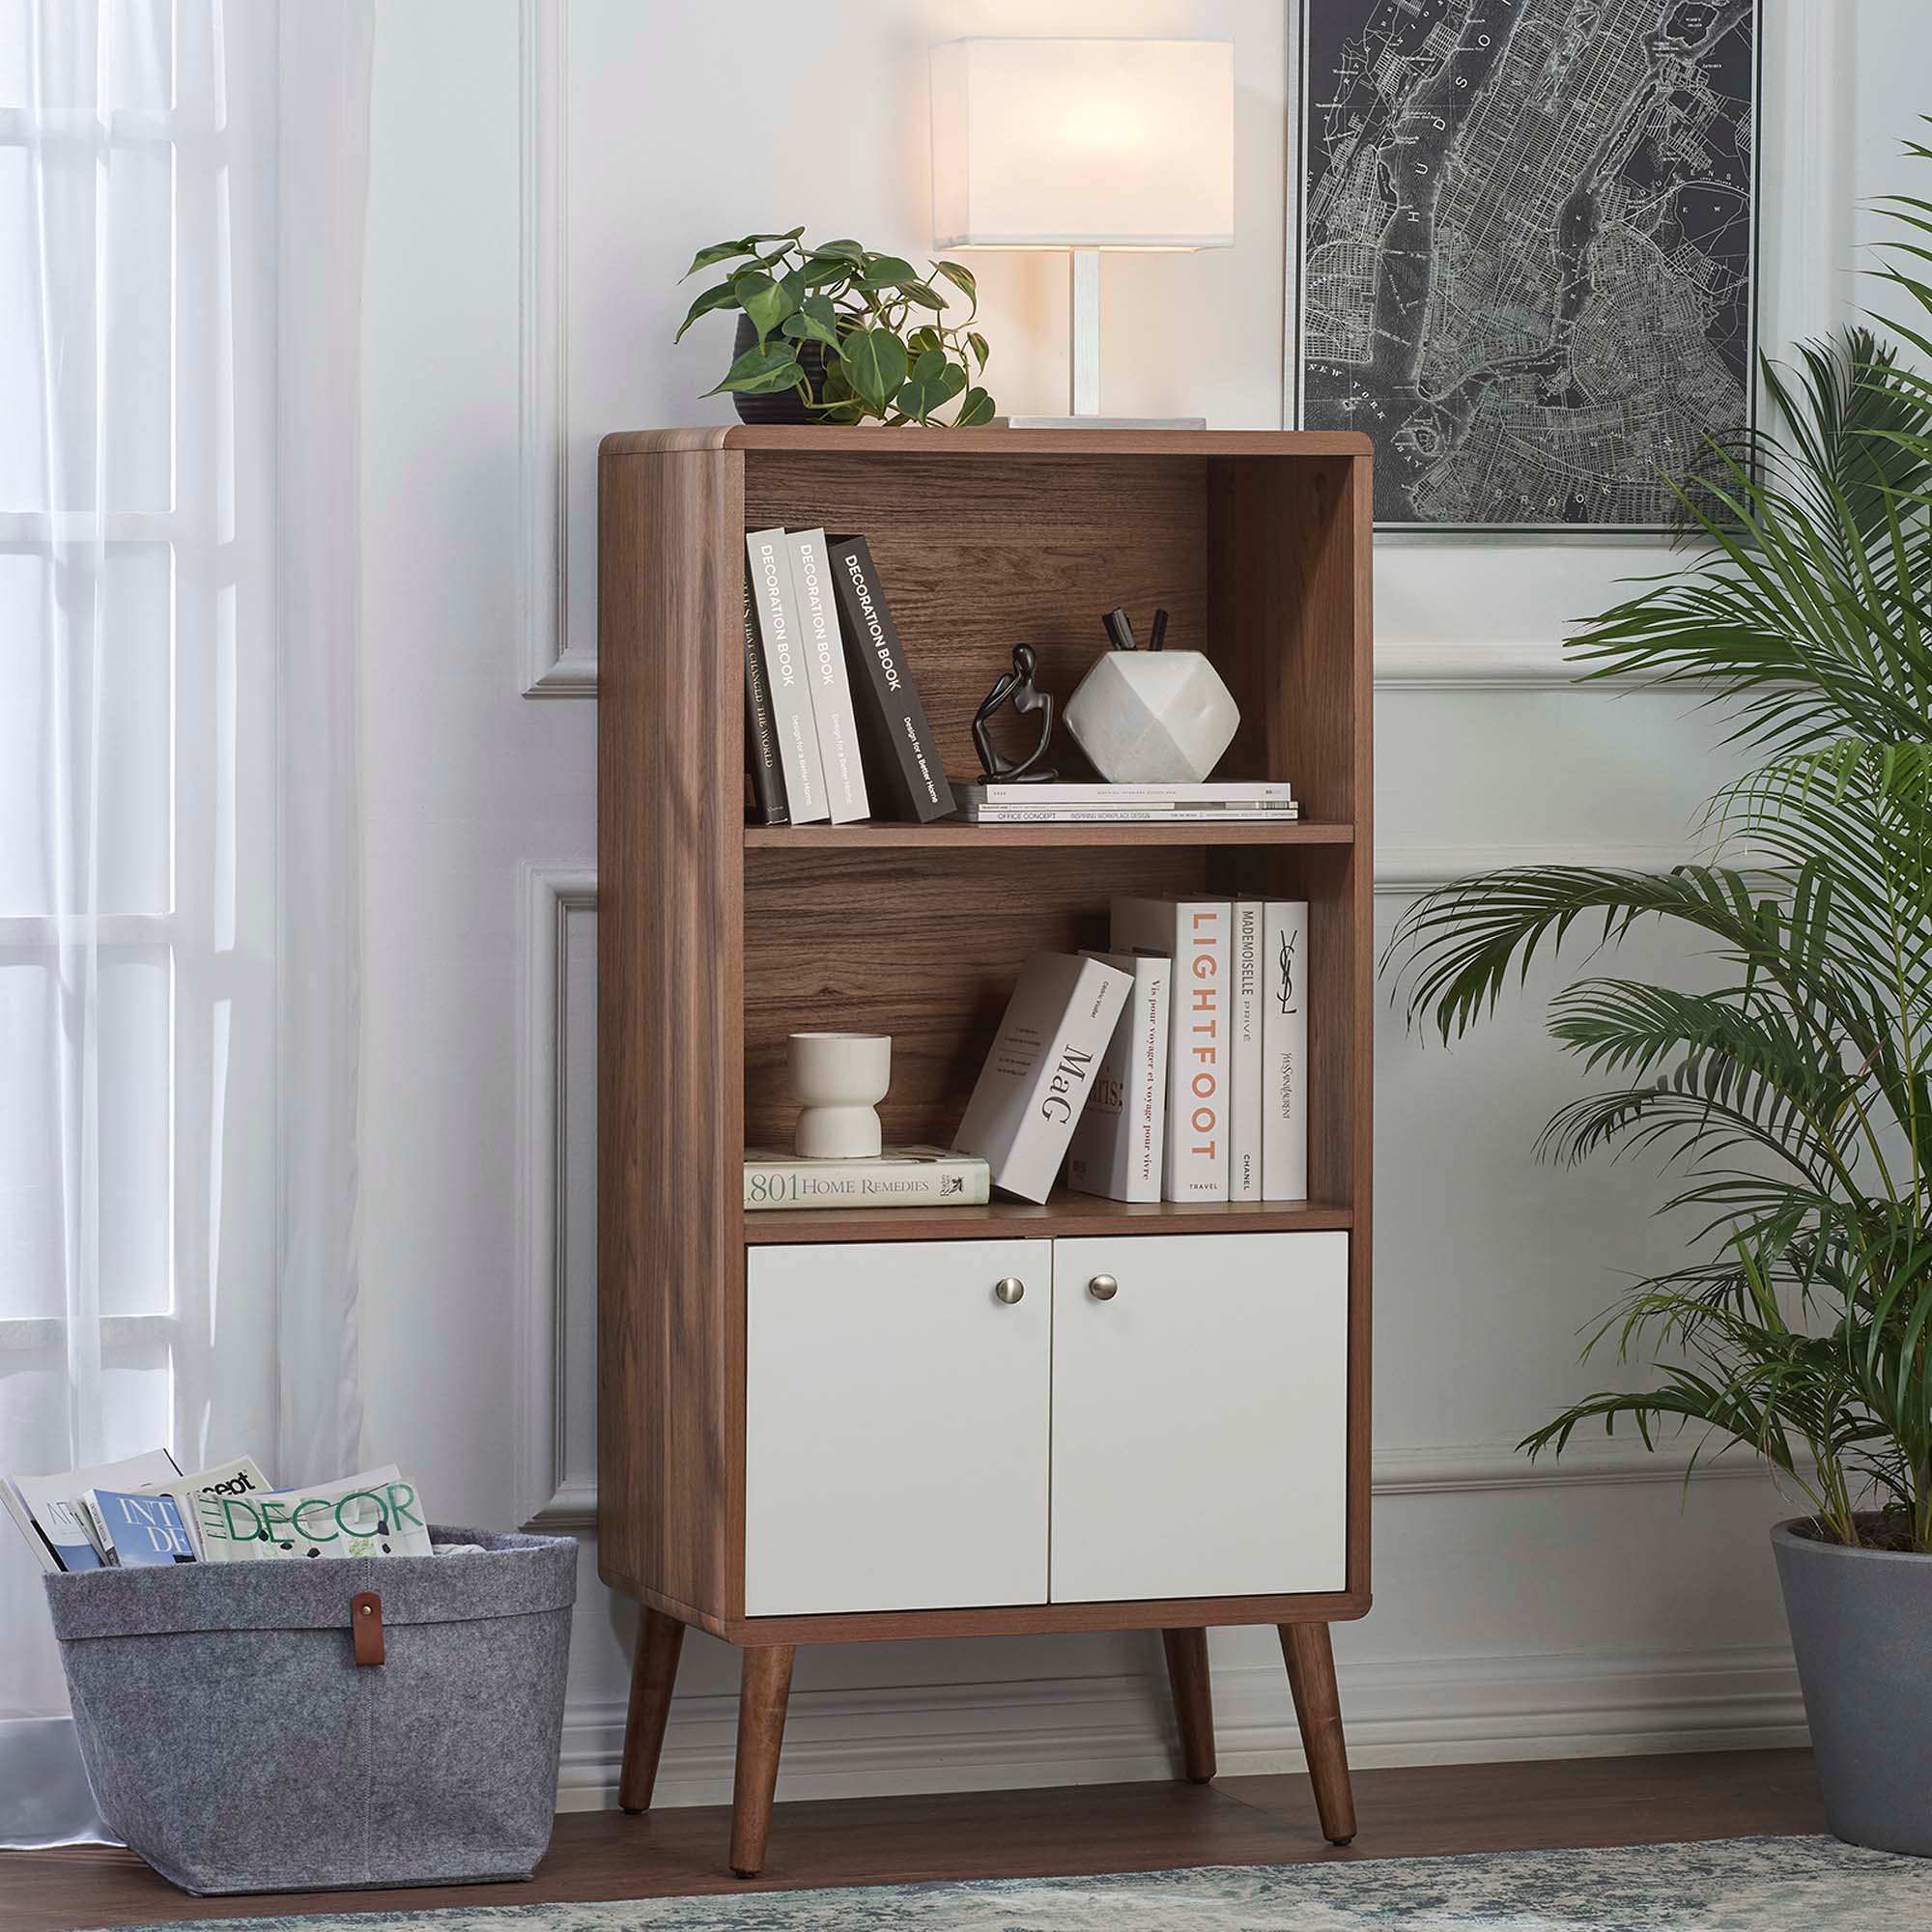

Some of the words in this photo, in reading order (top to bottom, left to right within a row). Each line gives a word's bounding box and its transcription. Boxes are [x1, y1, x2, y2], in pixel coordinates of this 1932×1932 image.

[1352, 381, 1385, 419] YORK
[761, 544, 786, 640] DECORATION
[777, 642, 795, 687] BOOK
[801, 544, 827, 639] DECORATION
[817, 641, 834, 686] BOOK
[845, 554, 886, 648] DECORATION
[877, 647, 901, 692] BOOK
[756, 705, 767, 726] THE
[759, 726, 773, 767] WORLD
[902, 716, 918, 742] Design
[919, 758, 931, 781] Better
[926, 781, 939, 803] Home
[998, 811, 1022, 820] OFFICE
[1023, 811, 1056, 820] CONCEPT
[1241, 911, 1254, 995] MADEMOISELLE
[1149, 999, 1158, 1026] pour
[1145, 1028, 1155, 1069] voyager
[1191, 913, 1217, 1160] LIGHTFOOT
[1041, 1043, 1094, 1124] MaG
[1148, 1071, 1154, 1083] et
[1144, 1085, 1153, 1122] voyage
[1143, 1124, 1151, 1153] pour
[803, 1178, 855, 1194] HOME
[862, 1178, 929, 1195] REMEDIES
[1143, 1154, 1152, 1180] vivre
[222, 1483, 424, 1543] DECOR
